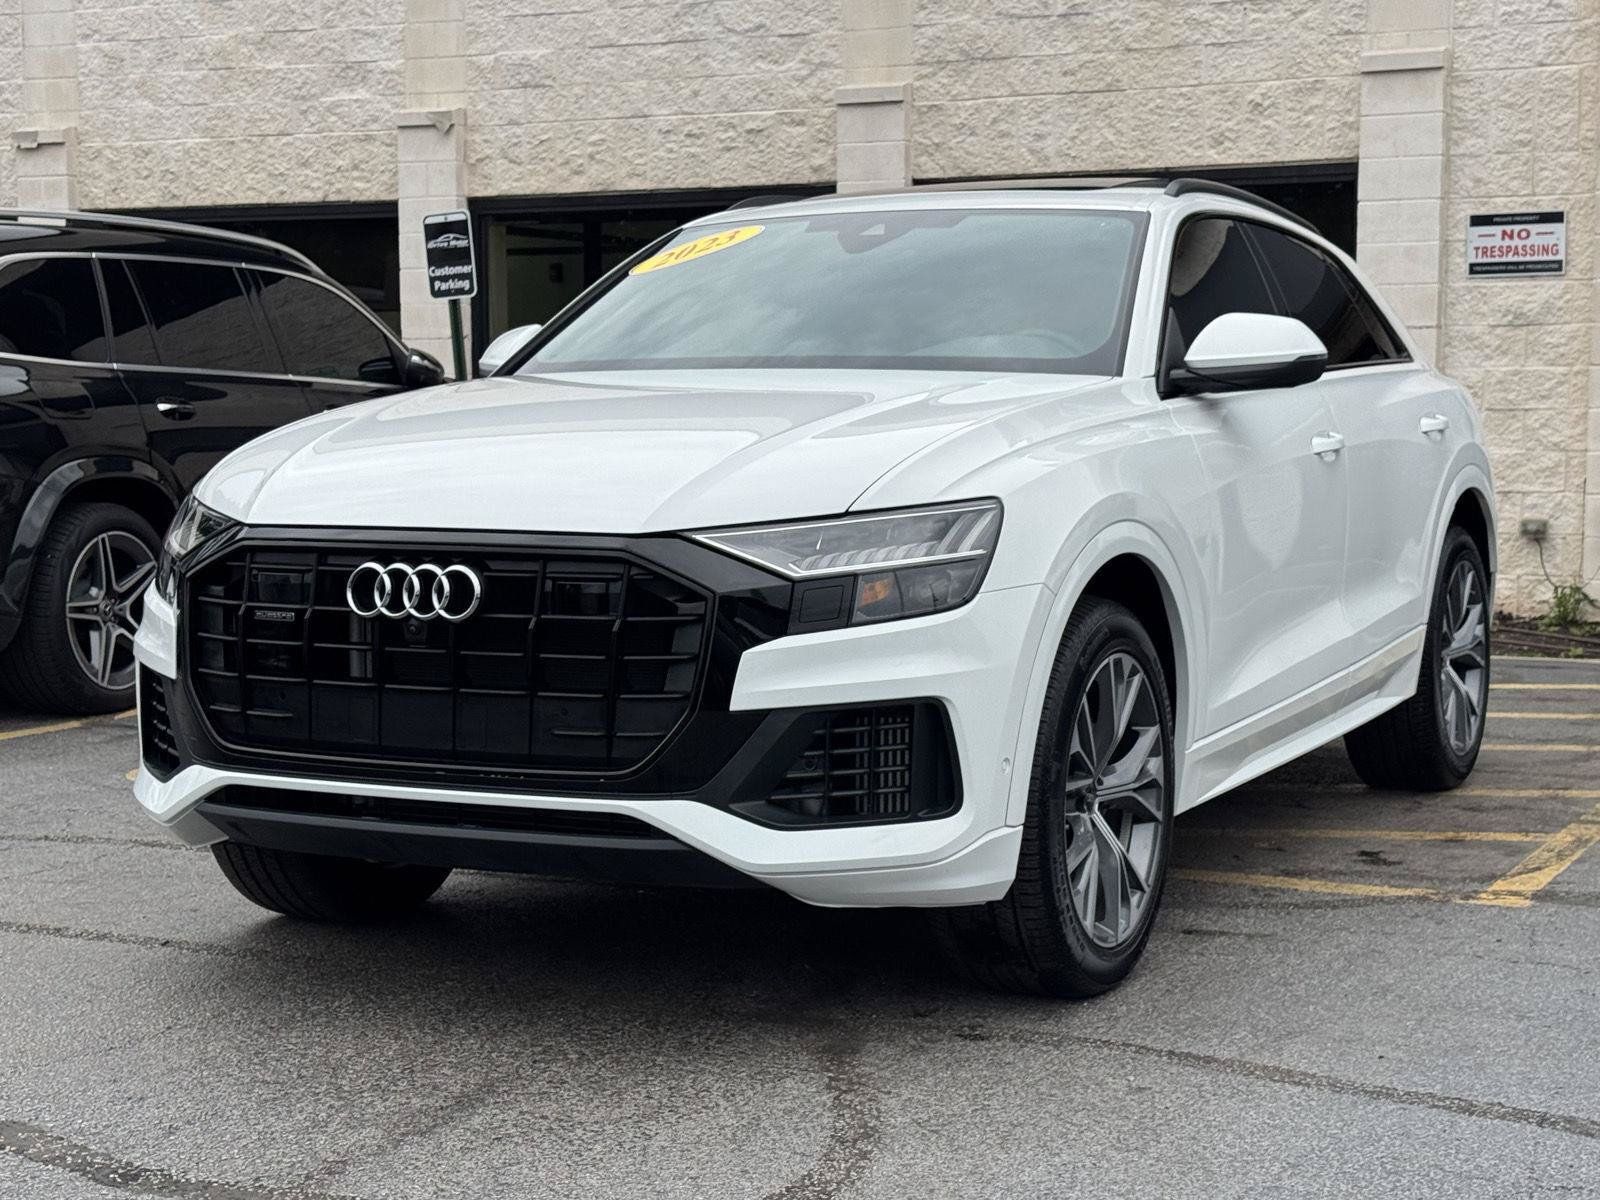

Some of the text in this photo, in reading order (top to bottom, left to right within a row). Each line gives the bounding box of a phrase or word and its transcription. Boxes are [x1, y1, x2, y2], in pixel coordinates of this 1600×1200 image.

[1500, 228, 1531, 241] NO
[651, 229, 742, 268] 2023
[1473, 242, 1560, 260] TRESPASSING
[429, 264, 472, 277] Customer
[434, 278, 470, 291] Parking
